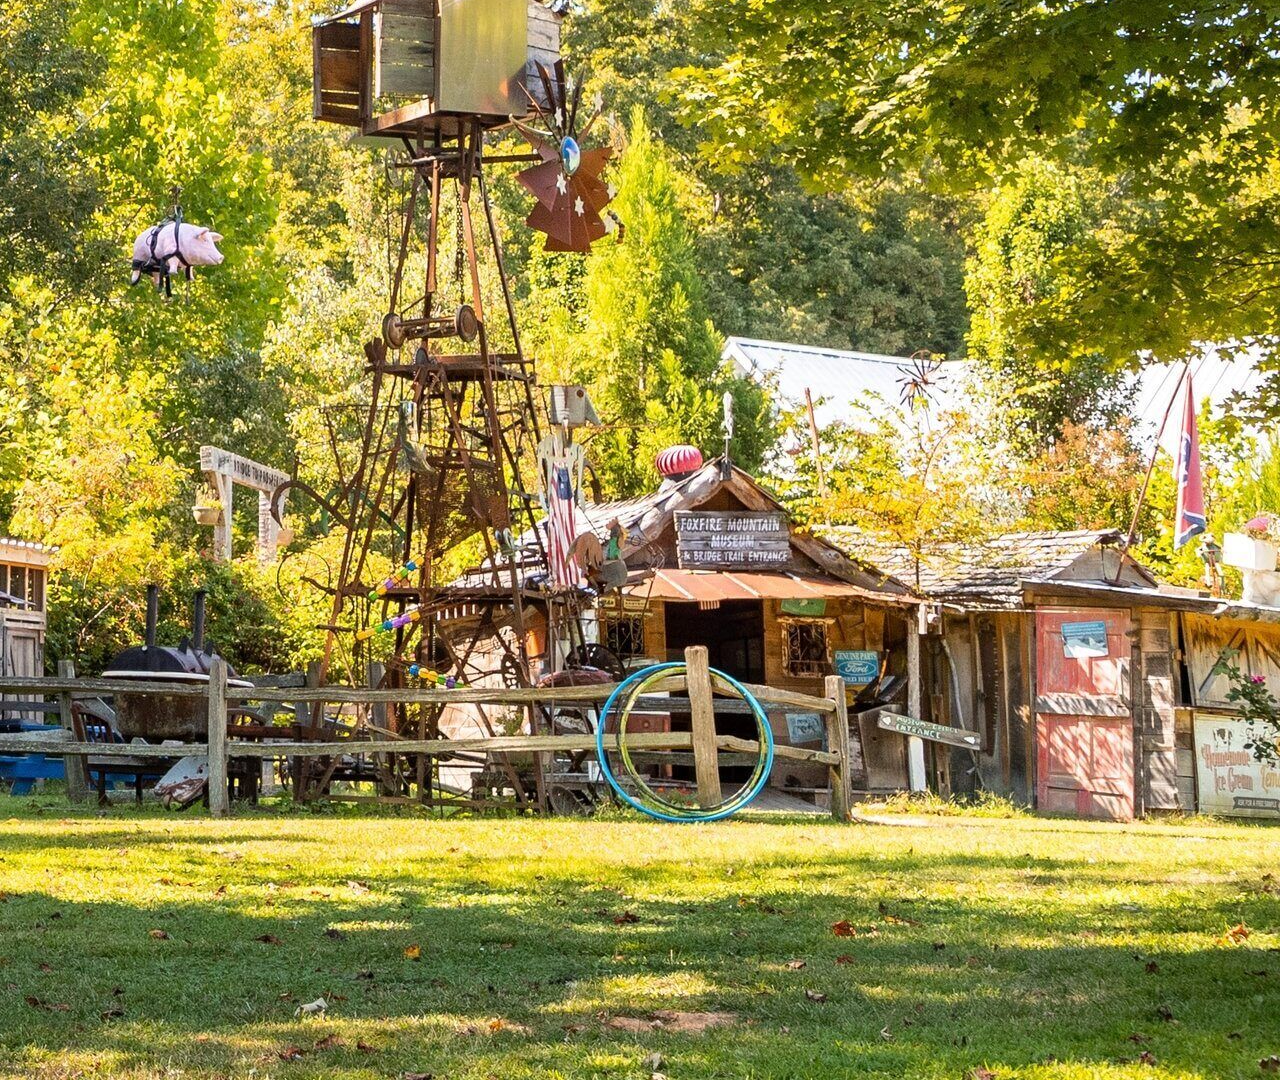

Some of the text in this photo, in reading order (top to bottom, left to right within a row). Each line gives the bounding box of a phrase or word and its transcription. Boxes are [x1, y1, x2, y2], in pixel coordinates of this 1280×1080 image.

[680, 518, 780, 531] FOXFIRE MOUNTAIN
[711, 534, 754, 548] MUSEUM
[683, 551, 788, 561] & BRIDGE TRAIL ENTRANCE
[844, 660, 869, 673] Ford
[895, 723, 941, 739] ENTRANCE
